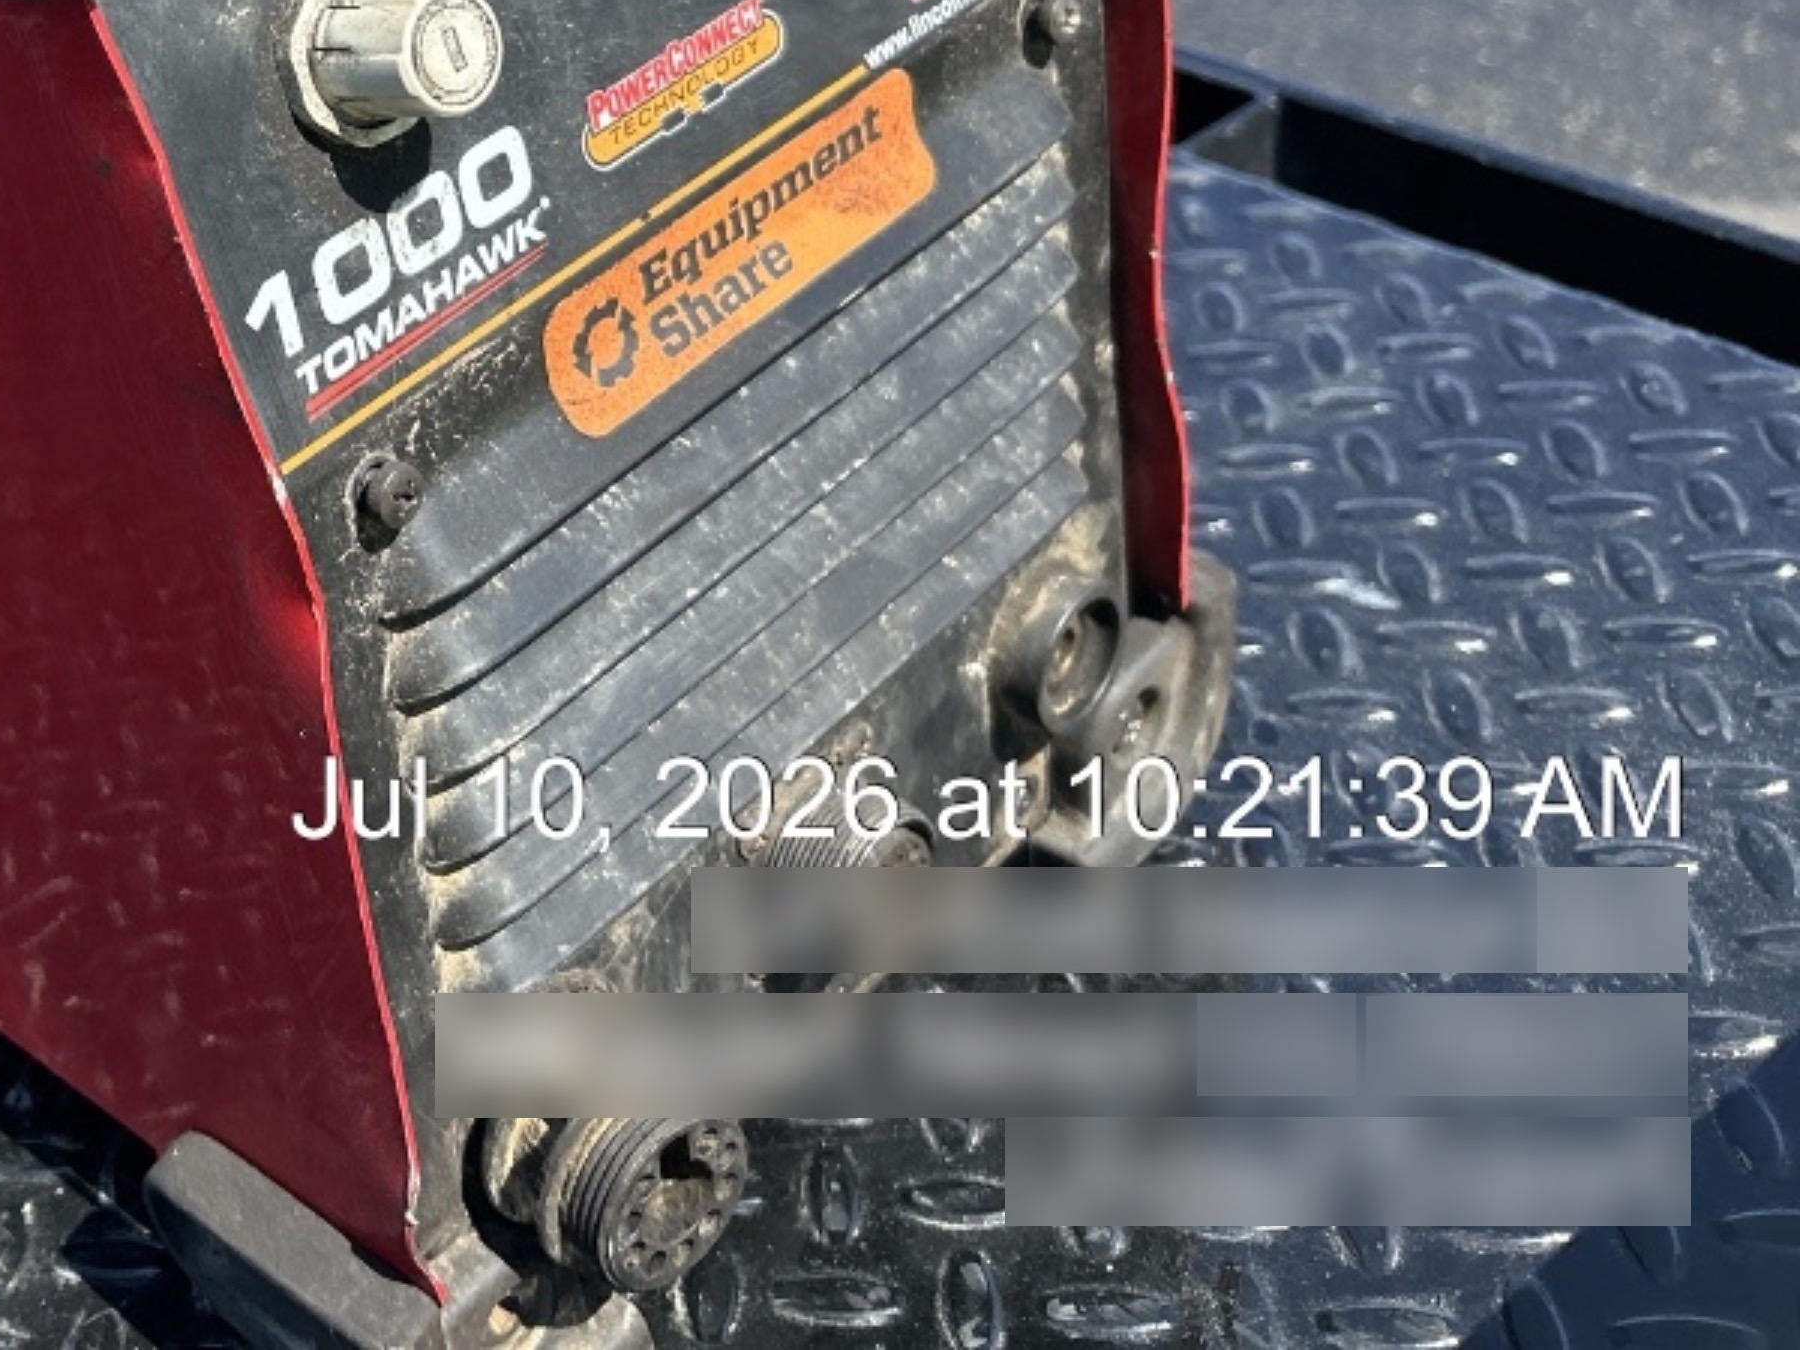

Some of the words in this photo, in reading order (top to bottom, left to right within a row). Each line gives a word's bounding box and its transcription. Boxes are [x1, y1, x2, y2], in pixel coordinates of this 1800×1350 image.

[608, 38, 759, 145] TECHNOLOGY
[245, 125, 533, 358] 1000
[637, 103, 883, 306] Equipment
[295, 216, 549, 395] TOMAHAWK
[649, 237, 794, 359] Share
